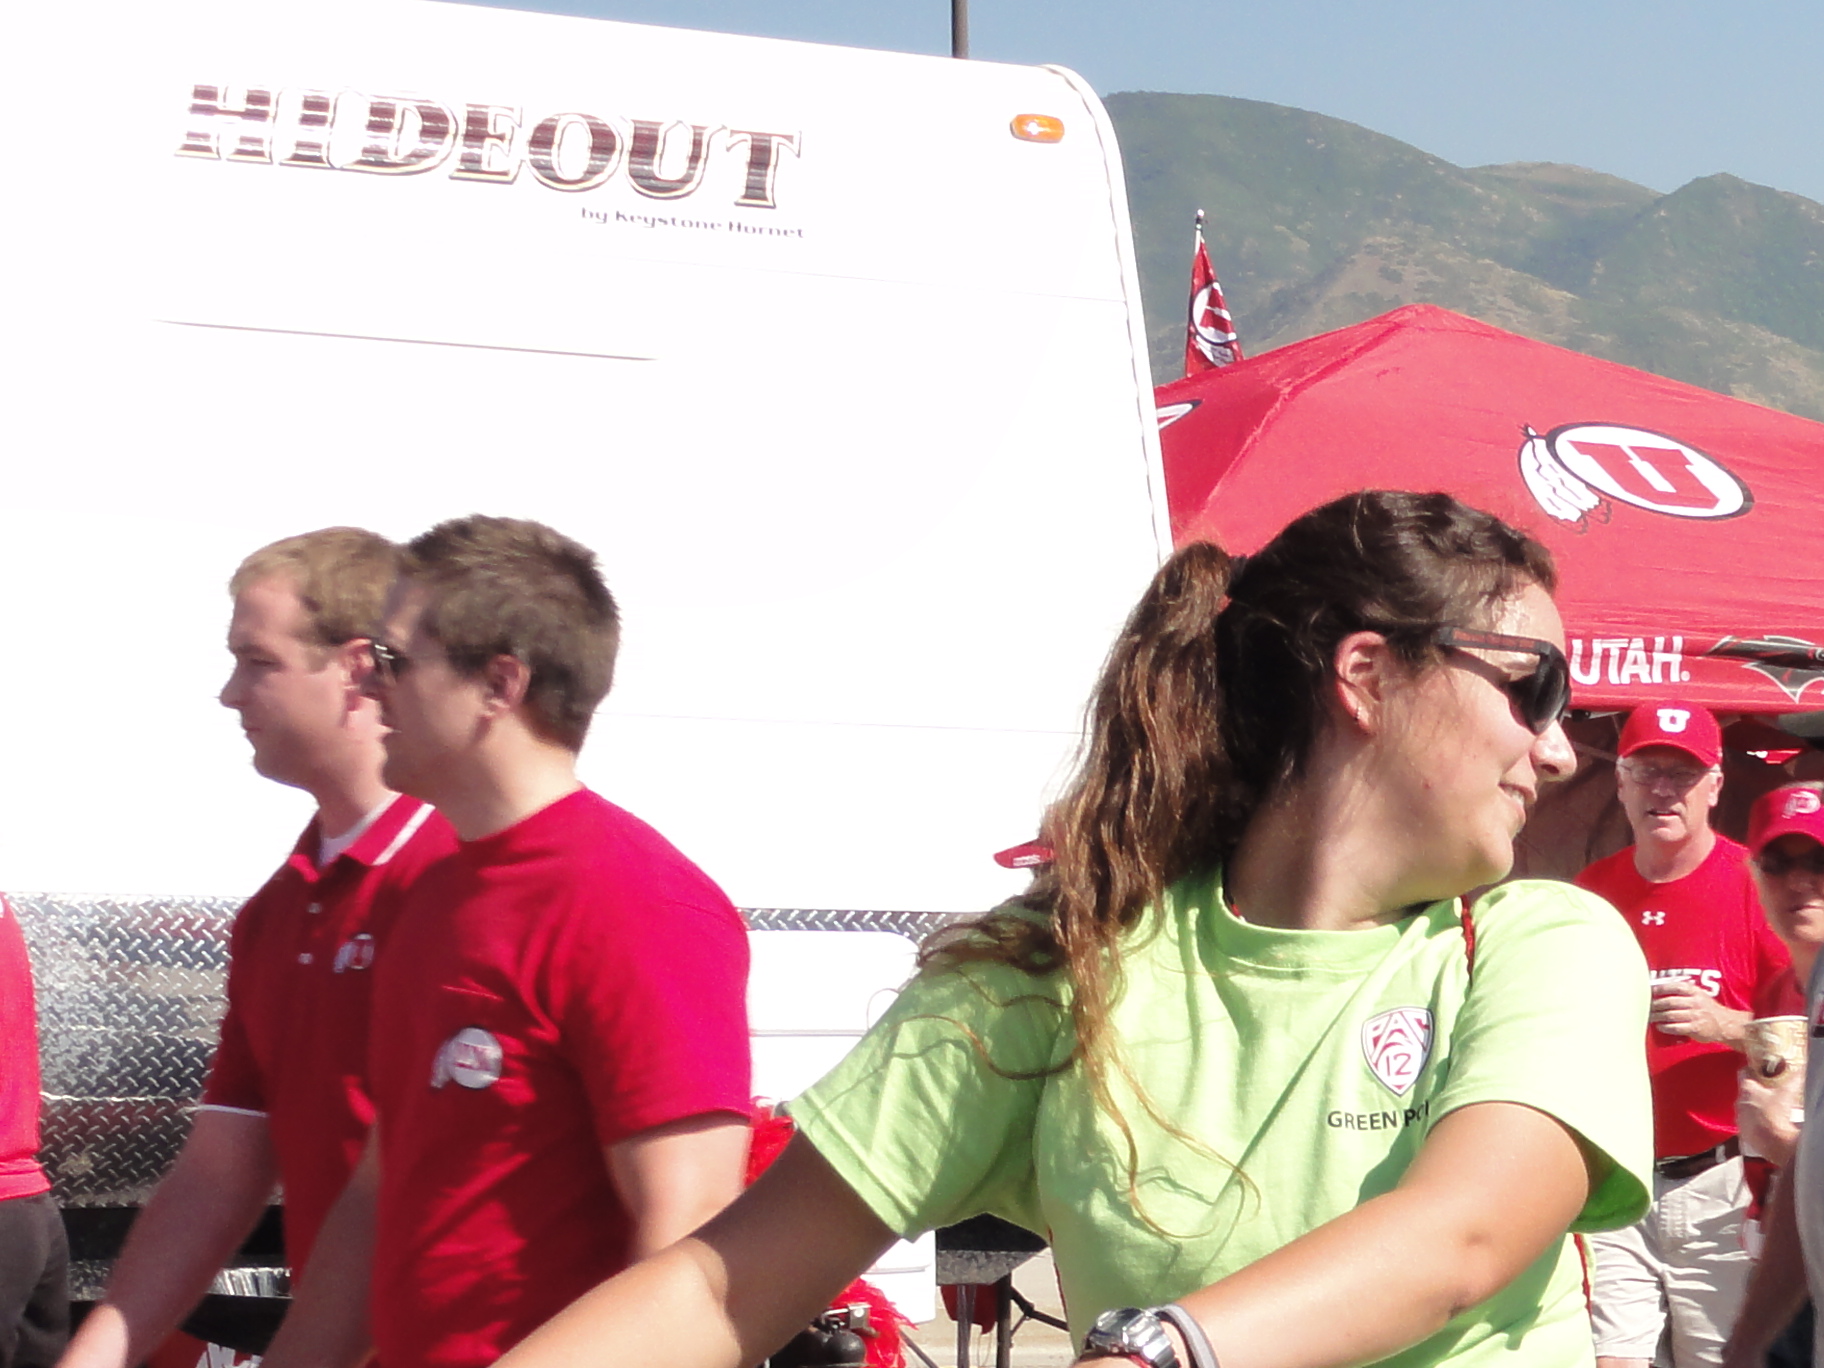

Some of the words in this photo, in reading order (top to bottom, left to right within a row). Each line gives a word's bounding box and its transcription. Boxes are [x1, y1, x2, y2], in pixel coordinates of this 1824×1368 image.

[175, 83, 801, 208] HIDEOUT
[581, 207, 608, 224] by
[1656, 708, 1691, 733] U
[1386, 1052, 1413, 1076] 12
[1327, 1109, 1398, 1131] GREEN
